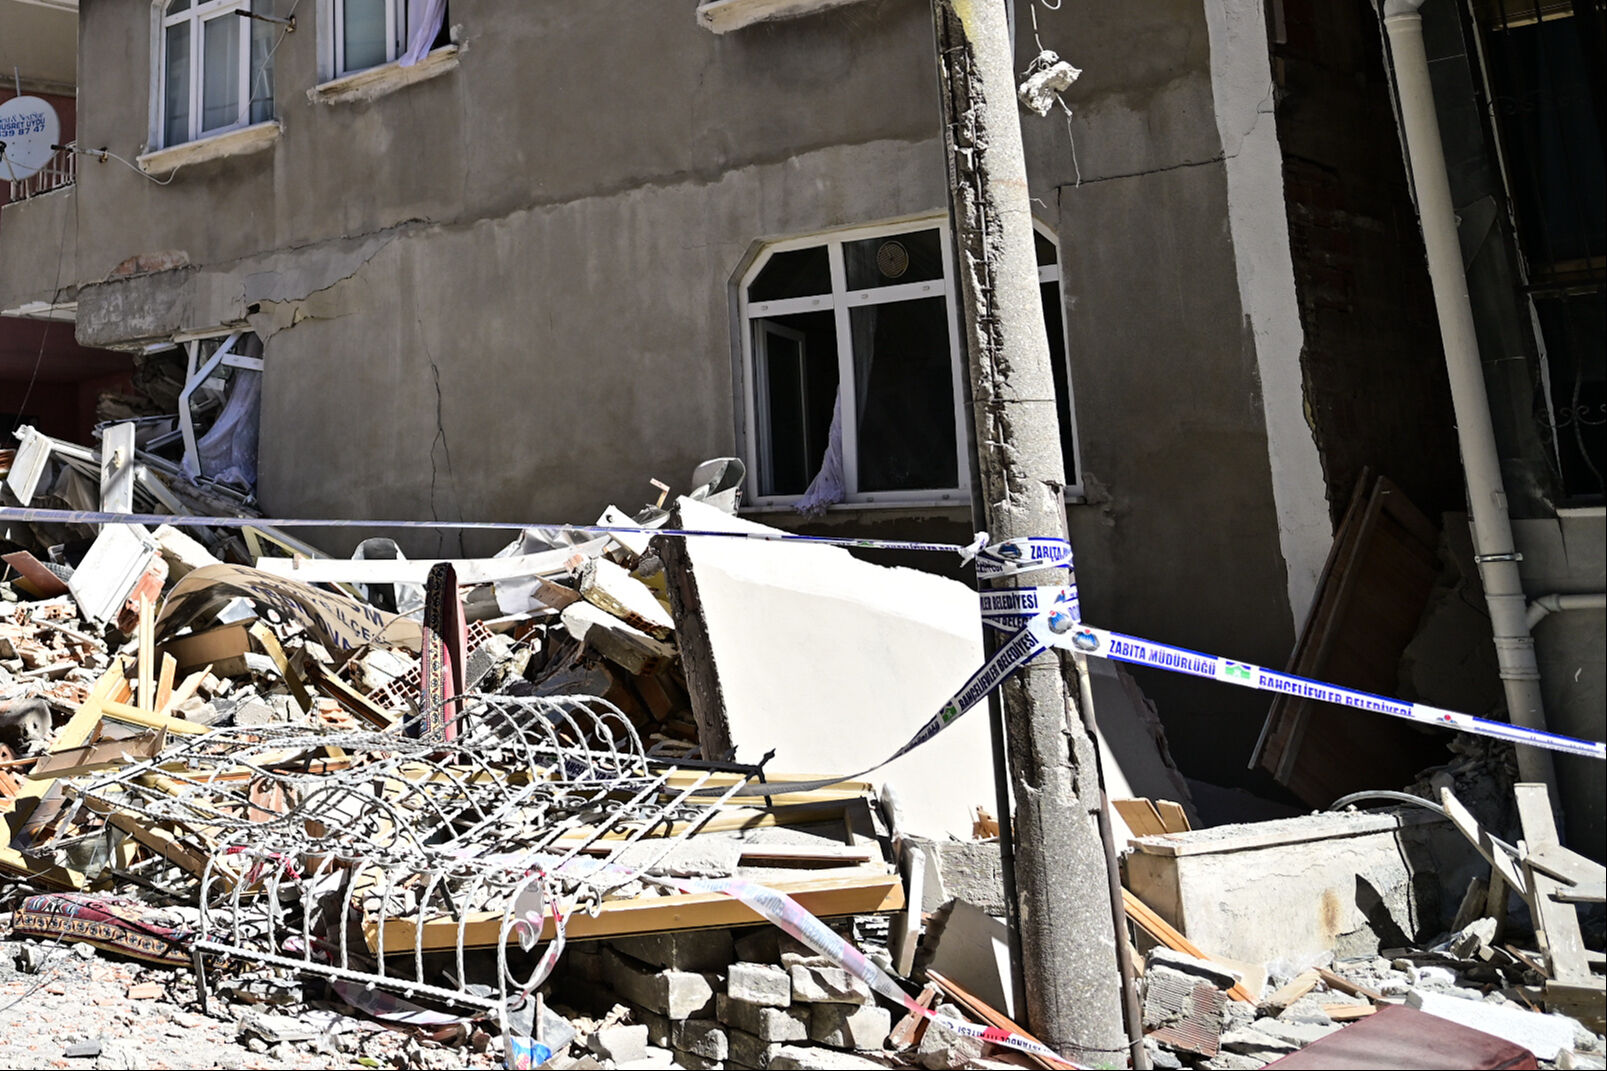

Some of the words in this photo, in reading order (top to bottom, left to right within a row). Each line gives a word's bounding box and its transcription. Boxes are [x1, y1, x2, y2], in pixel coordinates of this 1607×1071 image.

[992, 591, 1038, 610] BELEDİYESİ
[996, 629, 1039, 673] BELEDİYESİ
[1109, 639, 1147, 661] ZABITA
[1148, 646, 1216, 676] MÜDÜRLÜĞÜ
